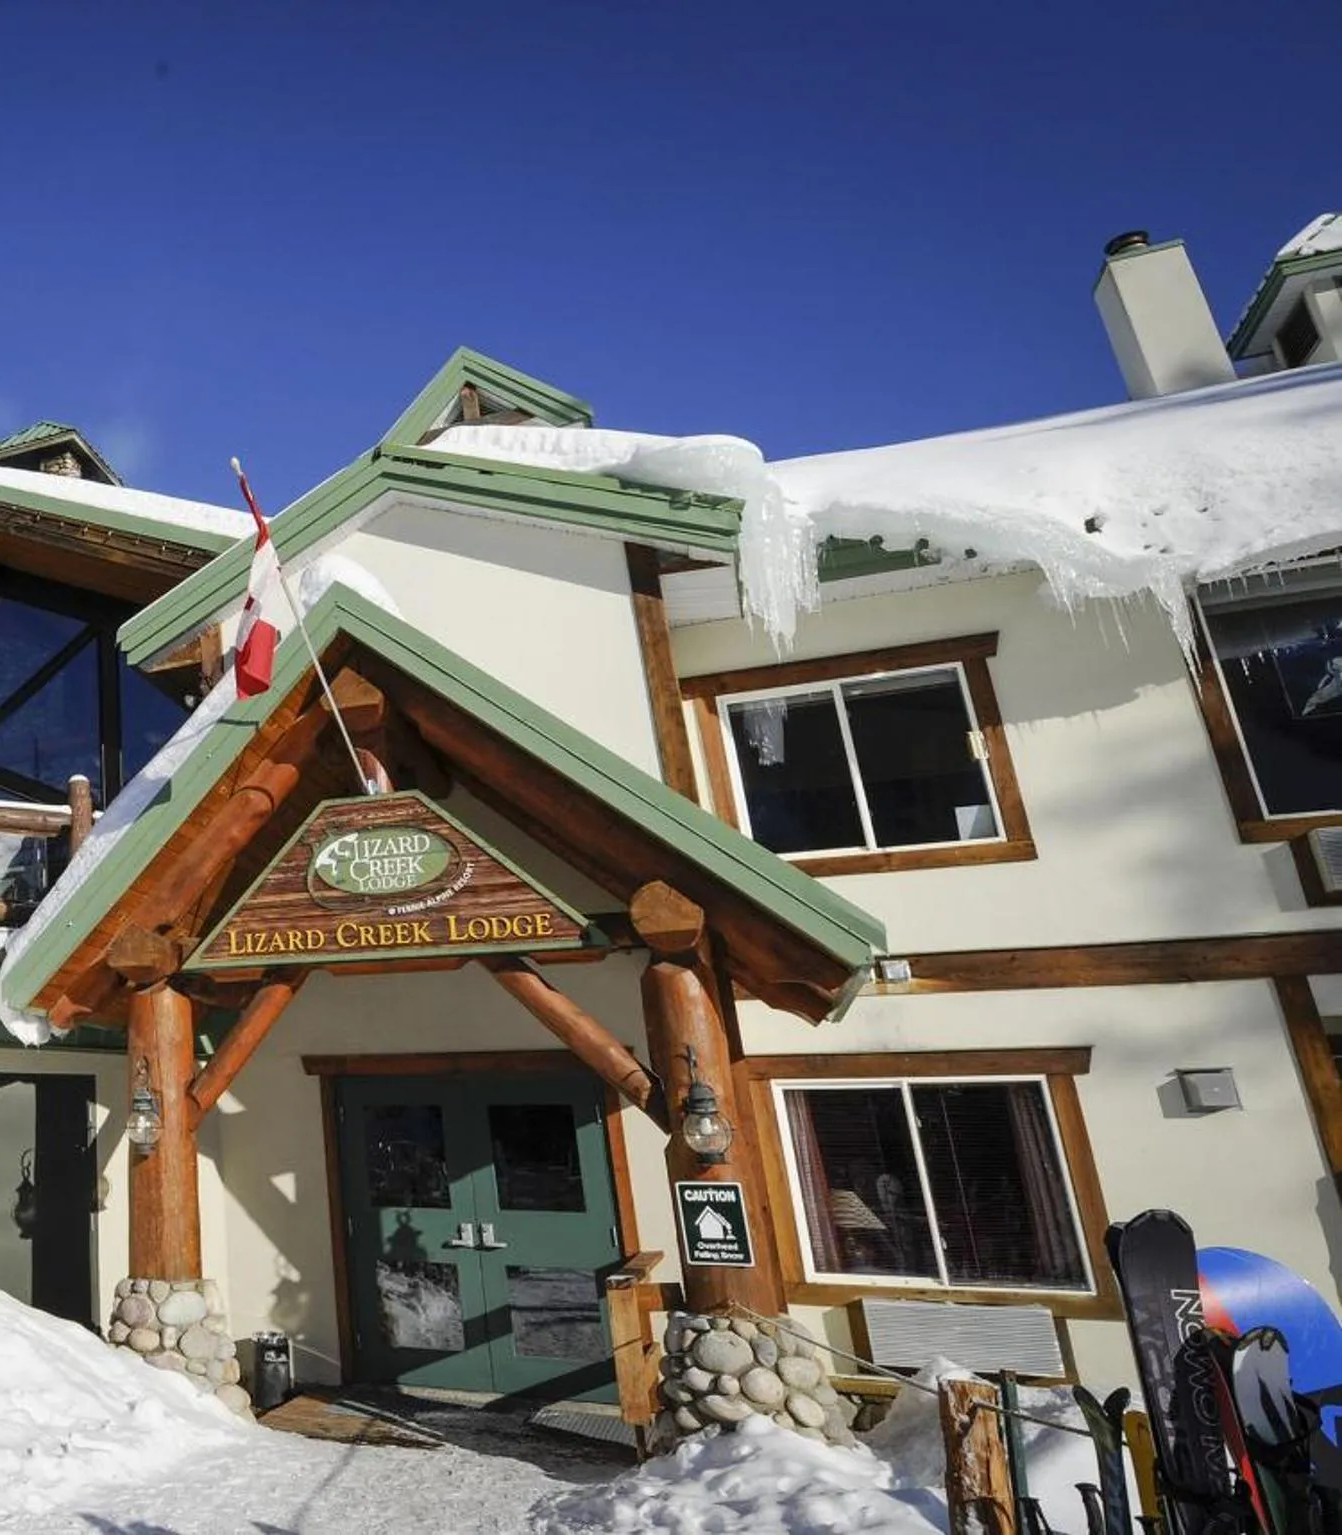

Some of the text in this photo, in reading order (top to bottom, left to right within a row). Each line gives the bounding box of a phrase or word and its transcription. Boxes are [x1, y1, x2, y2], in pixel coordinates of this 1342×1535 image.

[353, 834, 430, 863] LIZARD
[350, 856, 426, 881] CREEK
[359, 874, 418, 892] LODGE
[426, 888, 455, 908] ALPINE
[453, 862, 476, 892] RESORT
[227, 913, 555, 956] LIZARD CREEK LODGE
[684, 1188, 737, 1202] CAUTION
[694, 1250, 745, 1260] Falling Snow
[697, 1241, 739, 1251] Overhead
